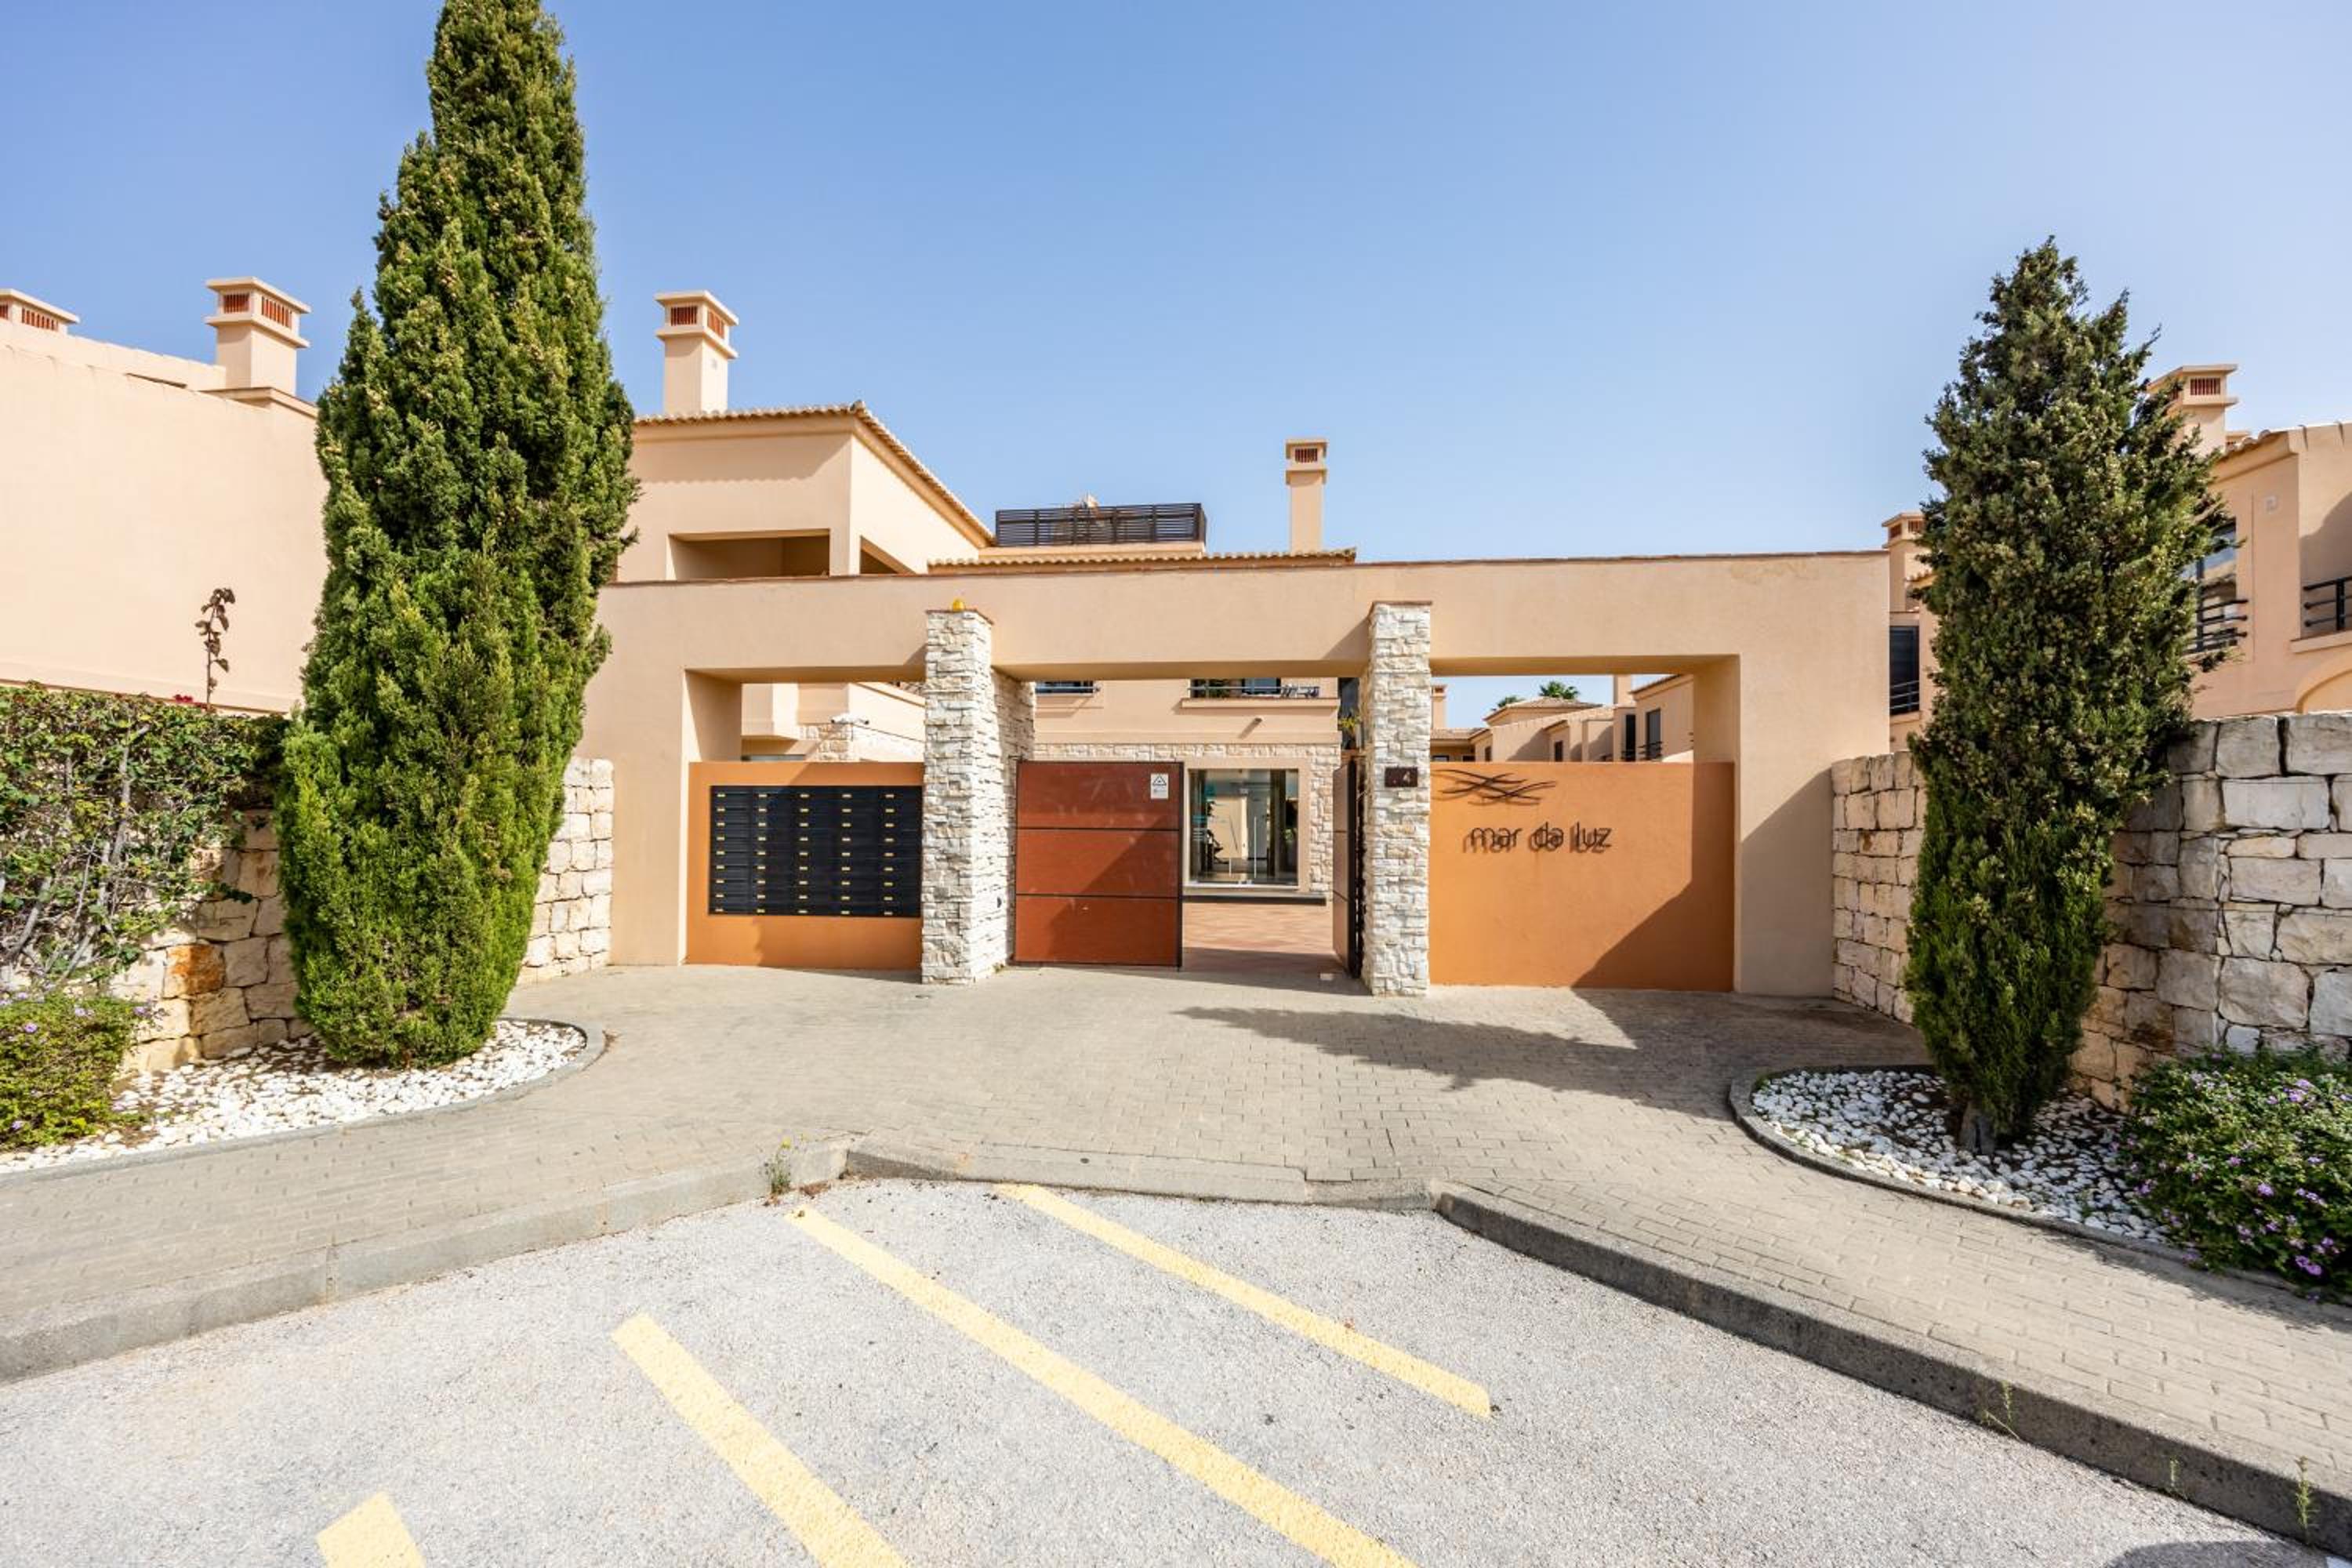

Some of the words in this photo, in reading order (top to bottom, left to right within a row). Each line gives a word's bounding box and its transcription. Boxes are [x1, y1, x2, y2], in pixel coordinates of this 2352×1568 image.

[1469, 827, 1523, 848] mar
[1534, 821, 1564, 849] da
[1576, 821, 1613, 849] luz
